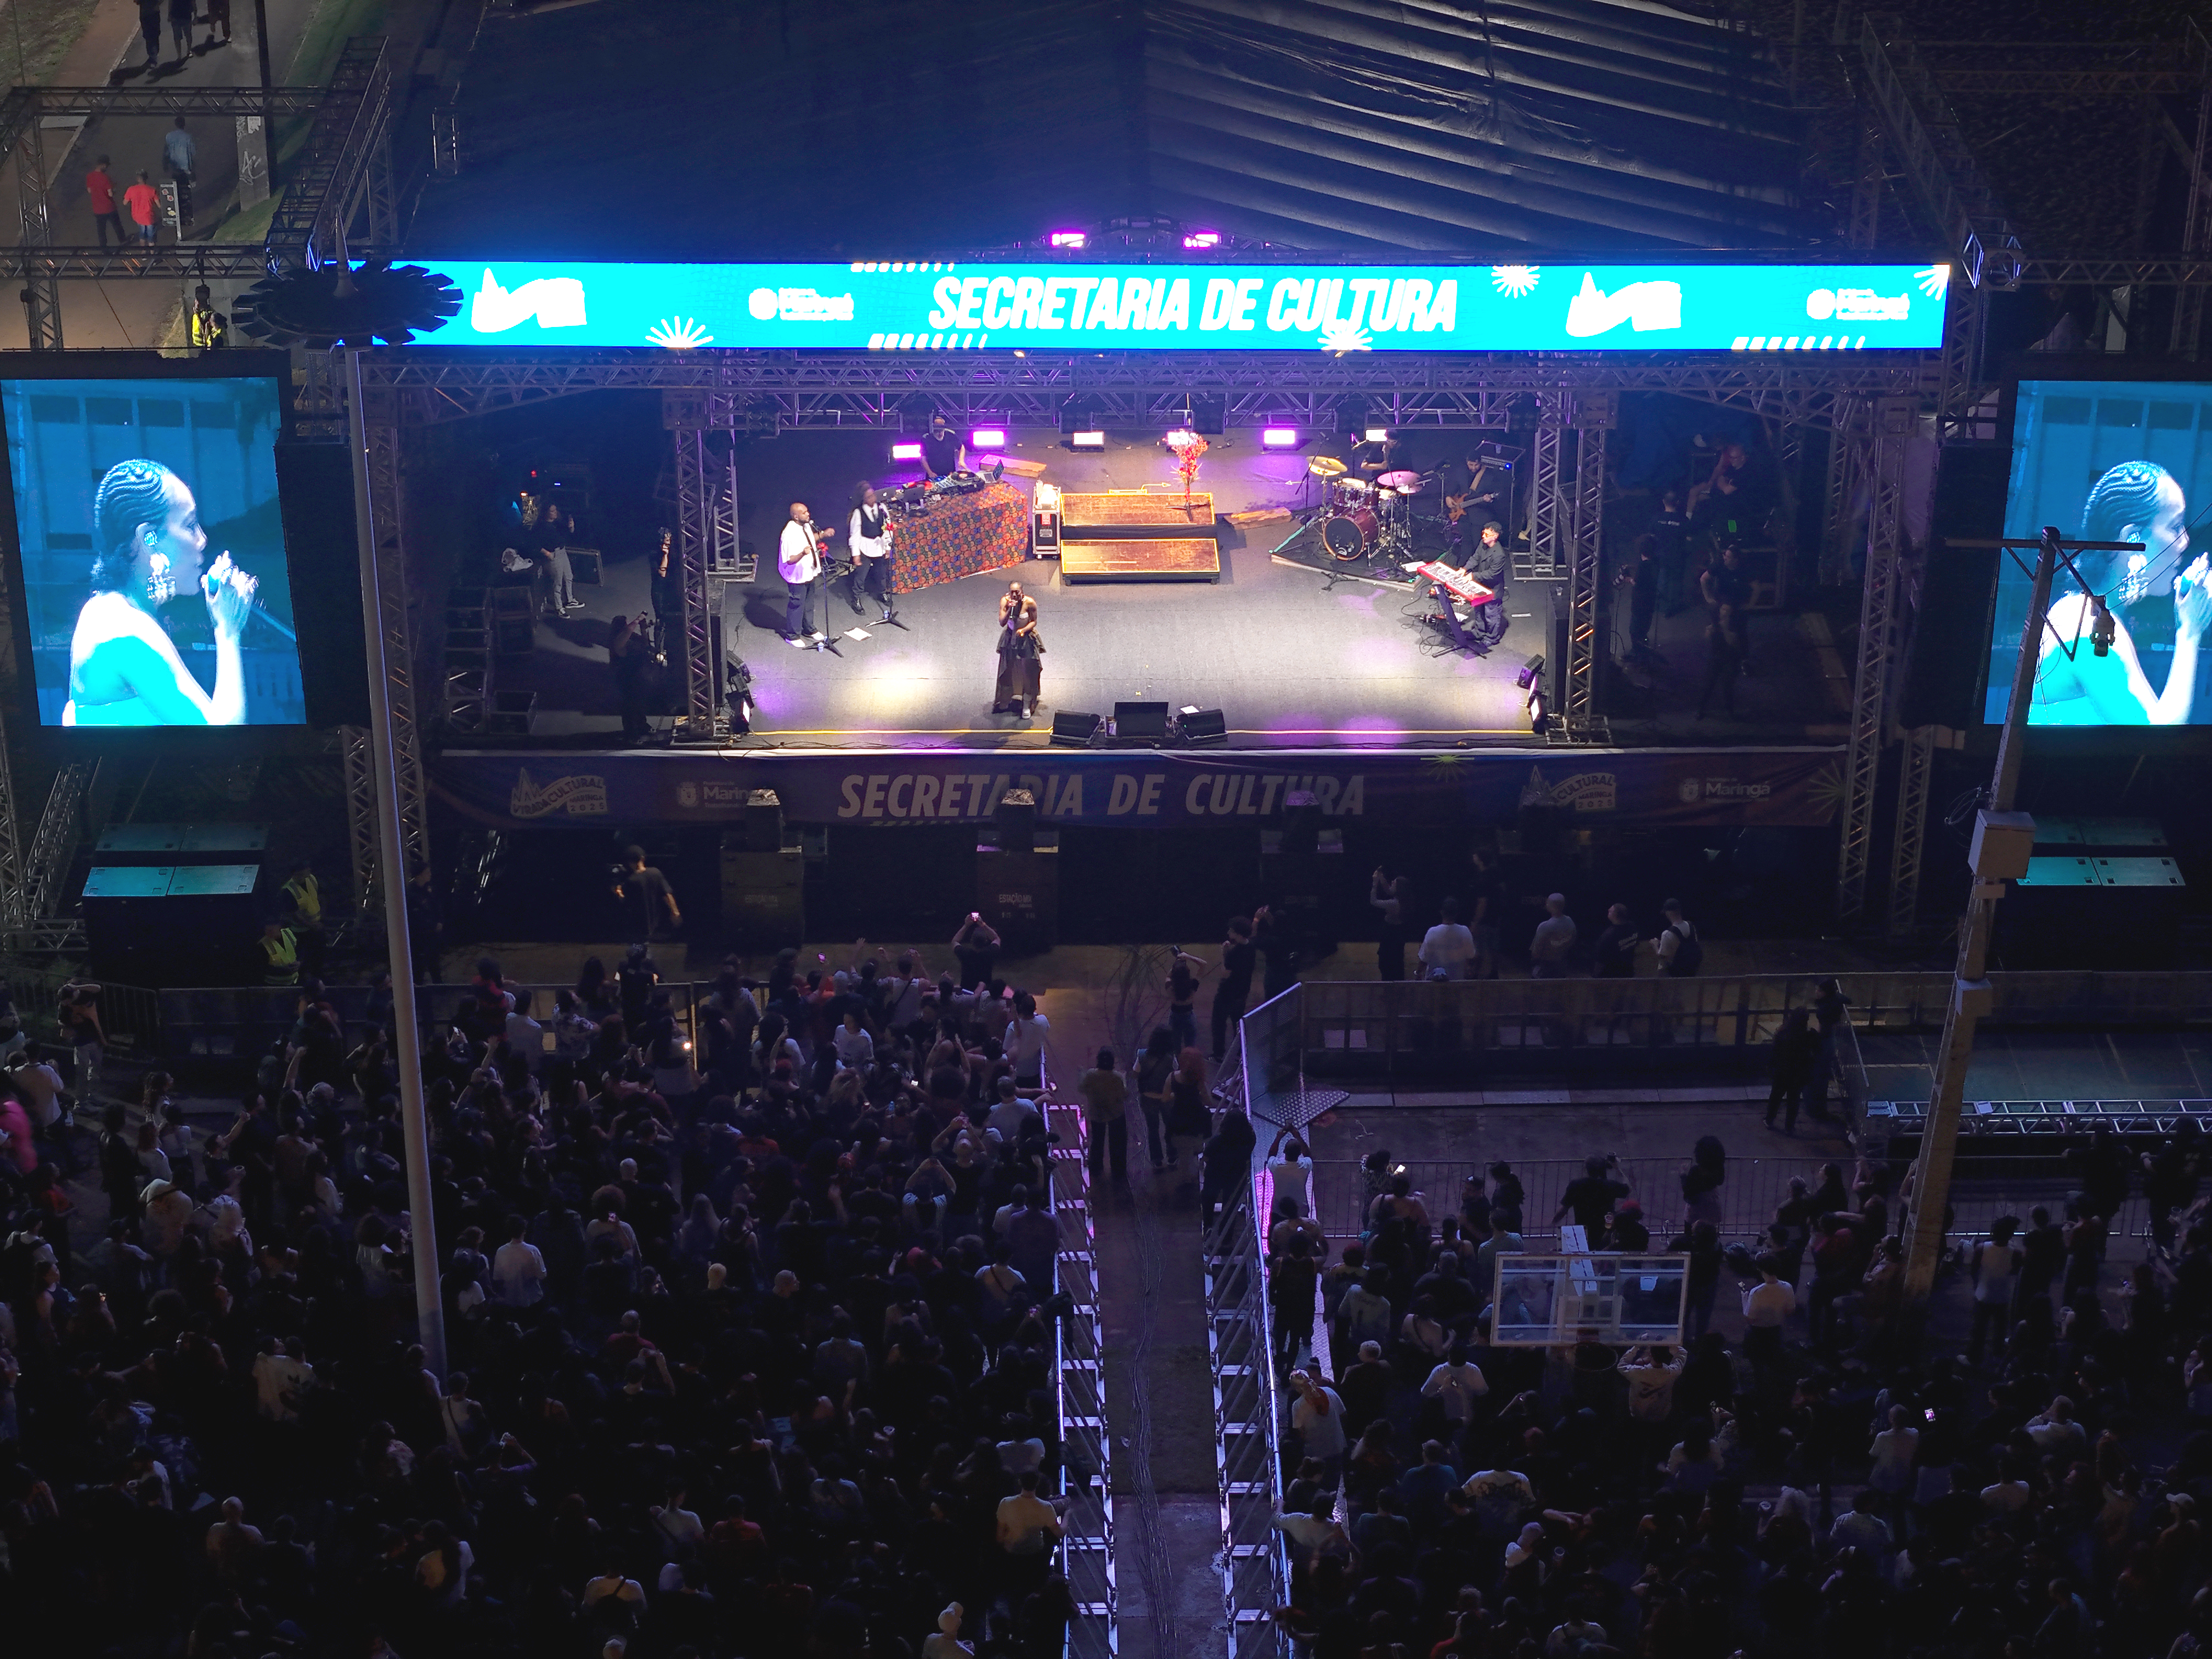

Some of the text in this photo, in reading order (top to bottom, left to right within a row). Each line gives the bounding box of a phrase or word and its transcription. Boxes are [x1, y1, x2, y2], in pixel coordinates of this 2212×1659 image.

[929, 276, 1457, 331] SECRETARIA DE CULTURA
[548, 778, 603, 803] CULTURAL
[703, 786, 752, 800] Marin
[1107, 774, 1165, 816] DE
[1557, 775, 1613, 800] CULTURAL
[1706, 780, 1771, 798] Maringá
[570, 802, 604, 812] 2025
[1578, 799, 1612, 809] 2025
